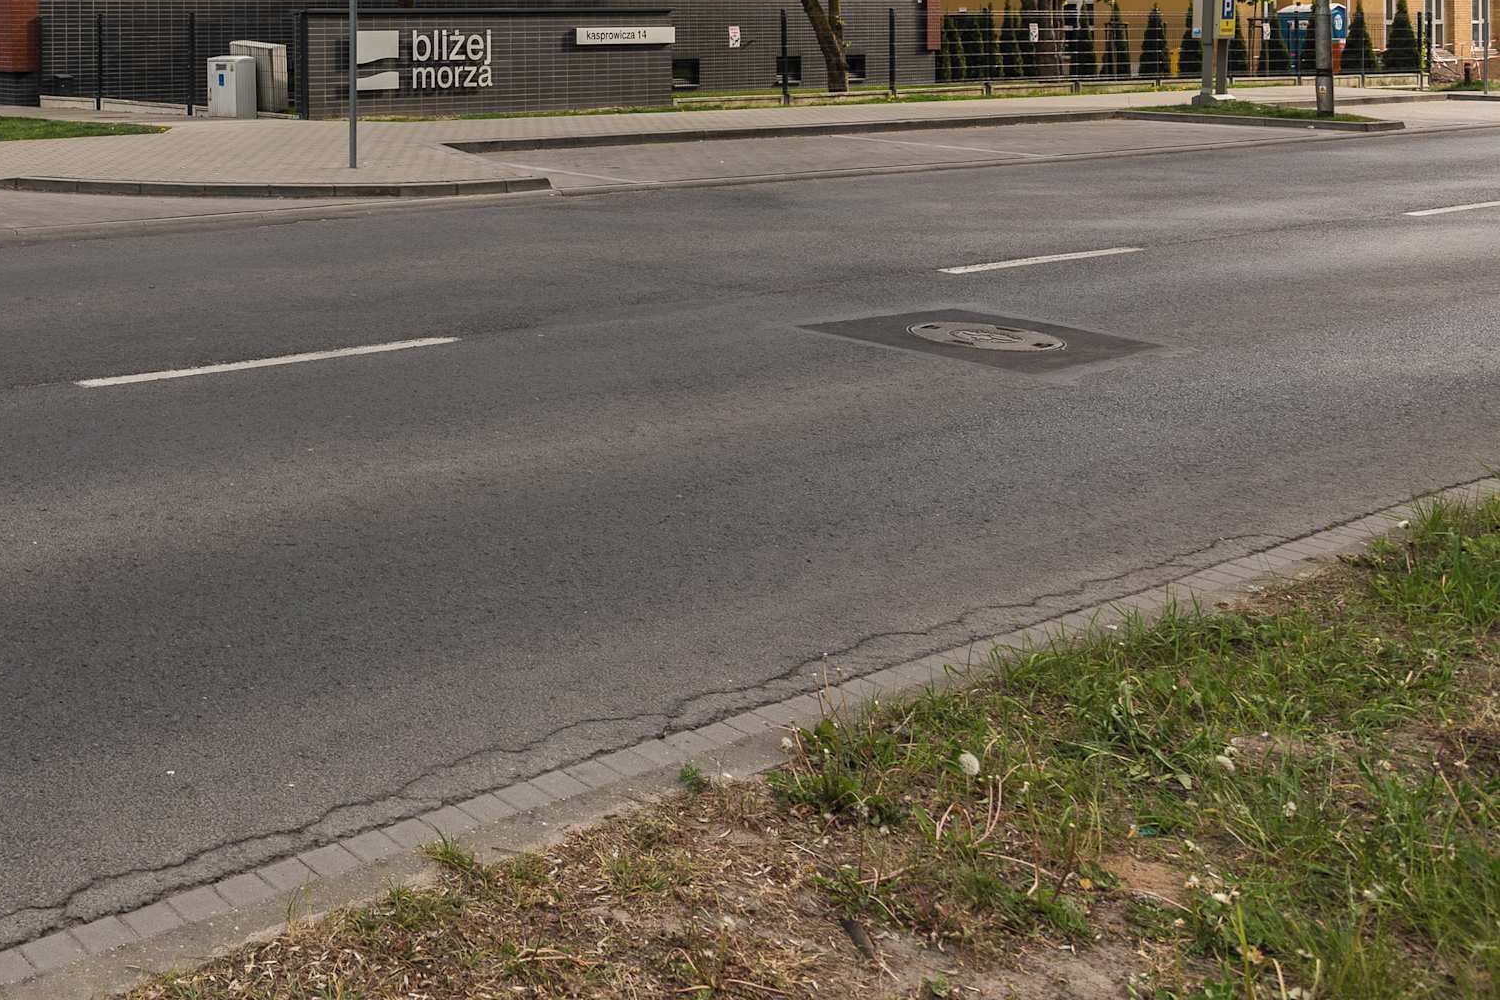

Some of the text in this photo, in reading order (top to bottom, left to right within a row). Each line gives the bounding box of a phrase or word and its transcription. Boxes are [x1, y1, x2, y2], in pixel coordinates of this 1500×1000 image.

[412, 29, 492, 65] bliżej
[586, 30, 647, 42] kasprowicza 14
[412, 65, 493, 89] morza
